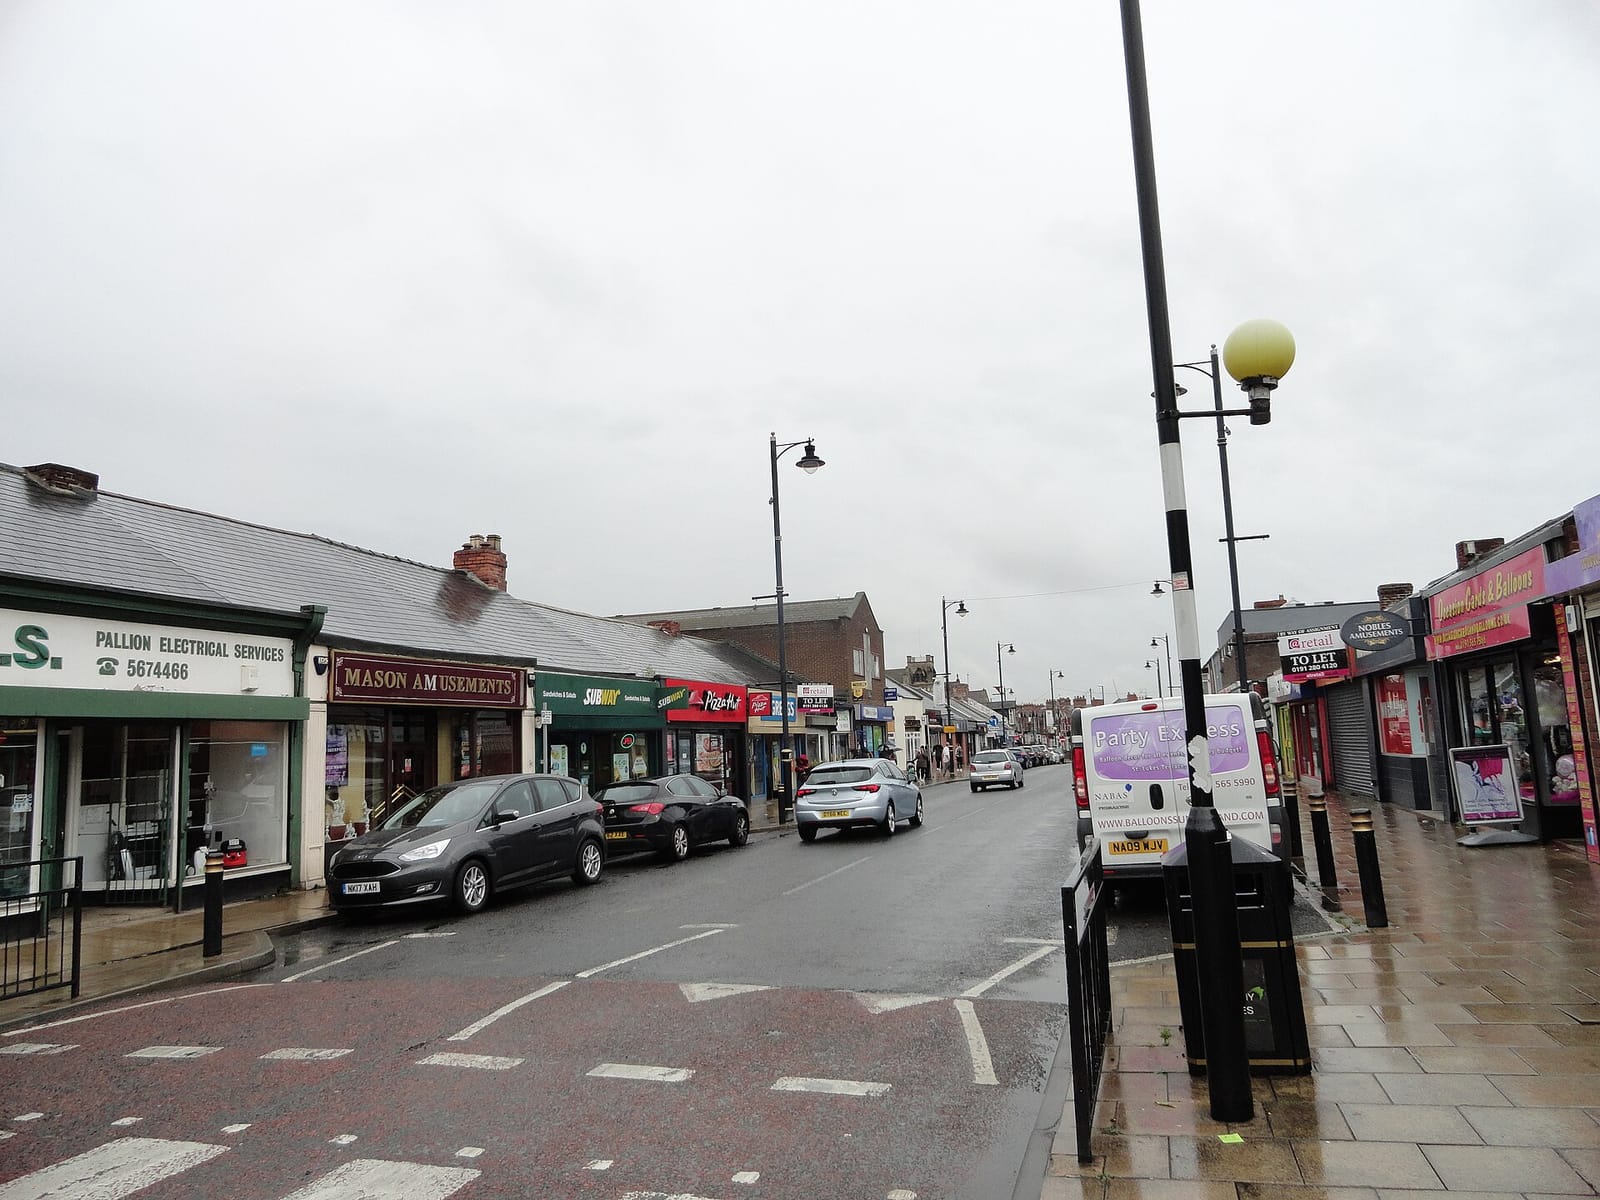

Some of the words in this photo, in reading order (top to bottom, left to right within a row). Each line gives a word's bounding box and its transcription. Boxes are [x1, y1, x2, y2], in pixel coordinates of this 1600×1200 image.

[1466, 587, 1487, 612] Cards
[1487, 580, 1495, 602] &
[1496, 569, 1533, 600] Balloons
[1349, 628, 1404, 639] AMUSEMENTS
[1358, 622, 1392, 632] NOBLES
[96, 630, 151, 651] PALLION
[160, 636, 229, 658] ELECTRICAL
[234, 643, 284, 662] SERVICES
[1290, 655, 1309, 666] TO
[1312, 652, 1336, 664] LET
[1322, 662, 1338, 670] 4120
[127, 659, 189, 680] 5674466
[344, 667, 407, 689] MASON
[413, 673, 512, 695] AMUSEMENTS
[583, 688, 621, 706] SUBWAY
[657, 688, 686, 709] SUBWAY
[704, 690, 726, 711] Pizza
[726, 692, 742, 710] Hut
[1096, 728, 1149, 748] Party
[1158, 722, 1240, 742] Exess
[1215, 780, 1232, 788] 565
[1234, 777, 1256, 787] 5990
[1095, 791, 1128, 801] NABAS
[1112, 841, 1139, 852] NA09
[1143, 840, 1163, 851] WJV
[364, 882, 378, 892] XAH
